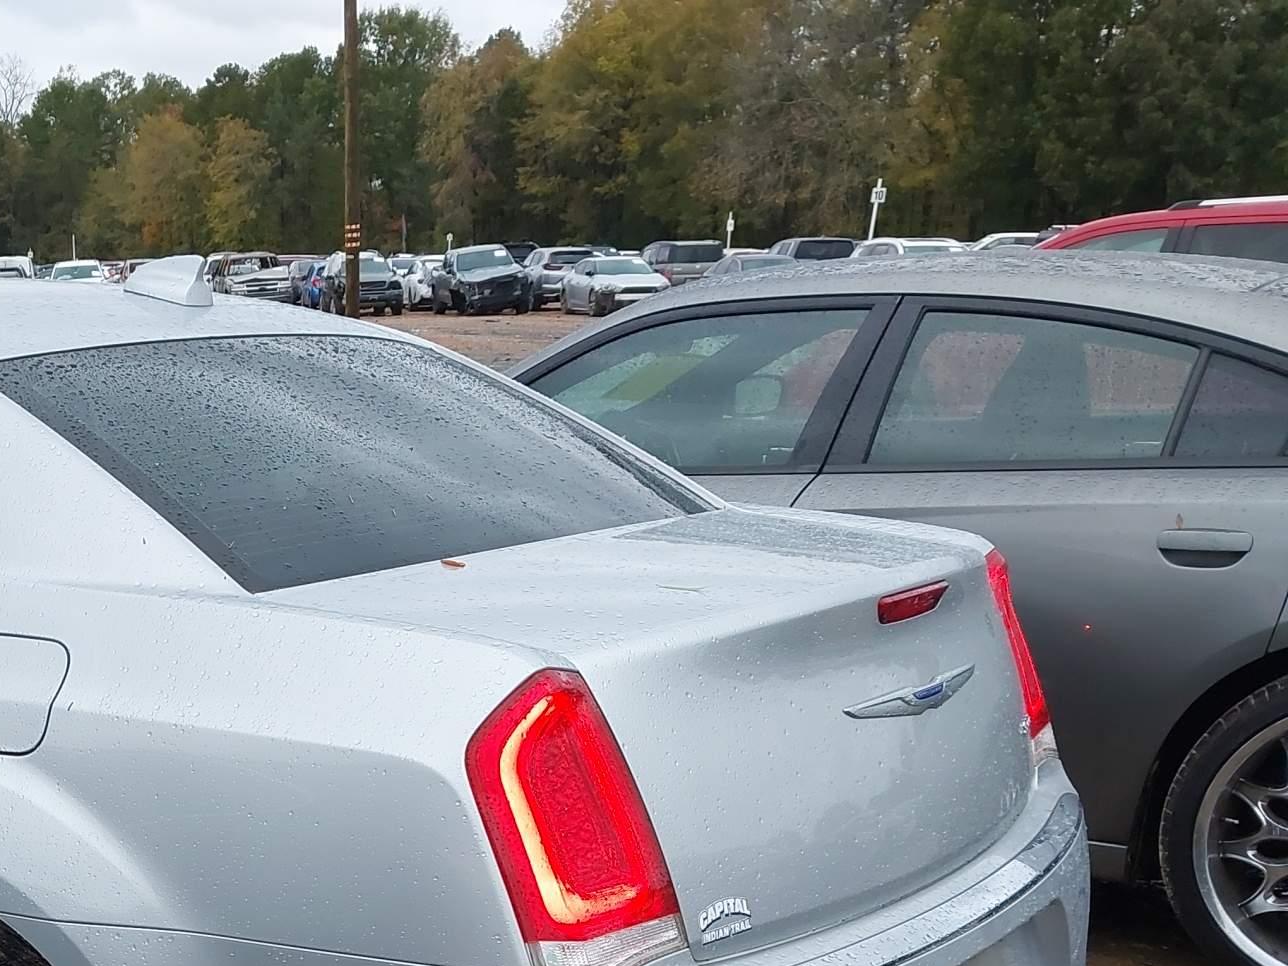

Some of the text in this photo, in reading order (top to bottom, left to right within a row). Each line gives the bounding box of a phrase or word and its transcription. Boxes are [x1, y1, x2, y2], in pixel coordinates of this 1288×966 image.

[874, 191, 883, 201] 10
[699, 898, 751, 932] CAPITAL
[703, 927, 730, 945] INDIAN
